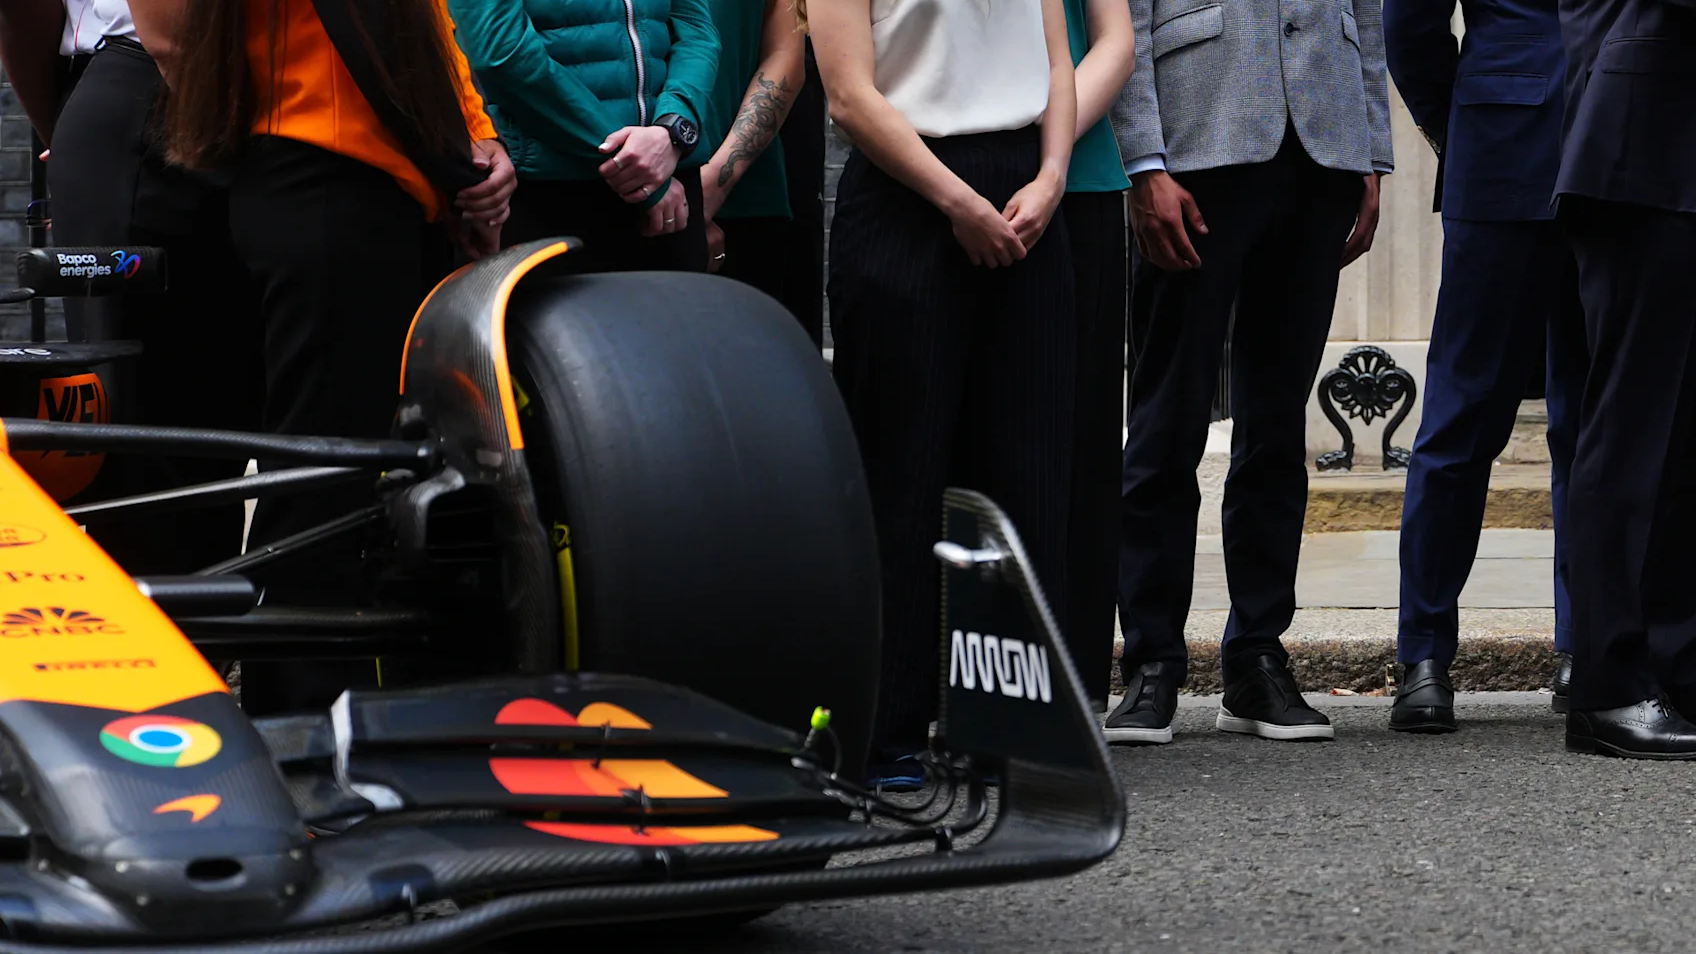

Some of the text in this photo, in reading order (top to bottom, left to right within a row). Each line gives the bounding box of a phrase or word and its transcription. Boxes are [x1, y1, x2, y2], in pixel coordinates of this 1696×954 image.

[57, 253, 97, 265] Bapco
[60, 264, 111, 278] energies
[0, 571, 85, 583] Pro
